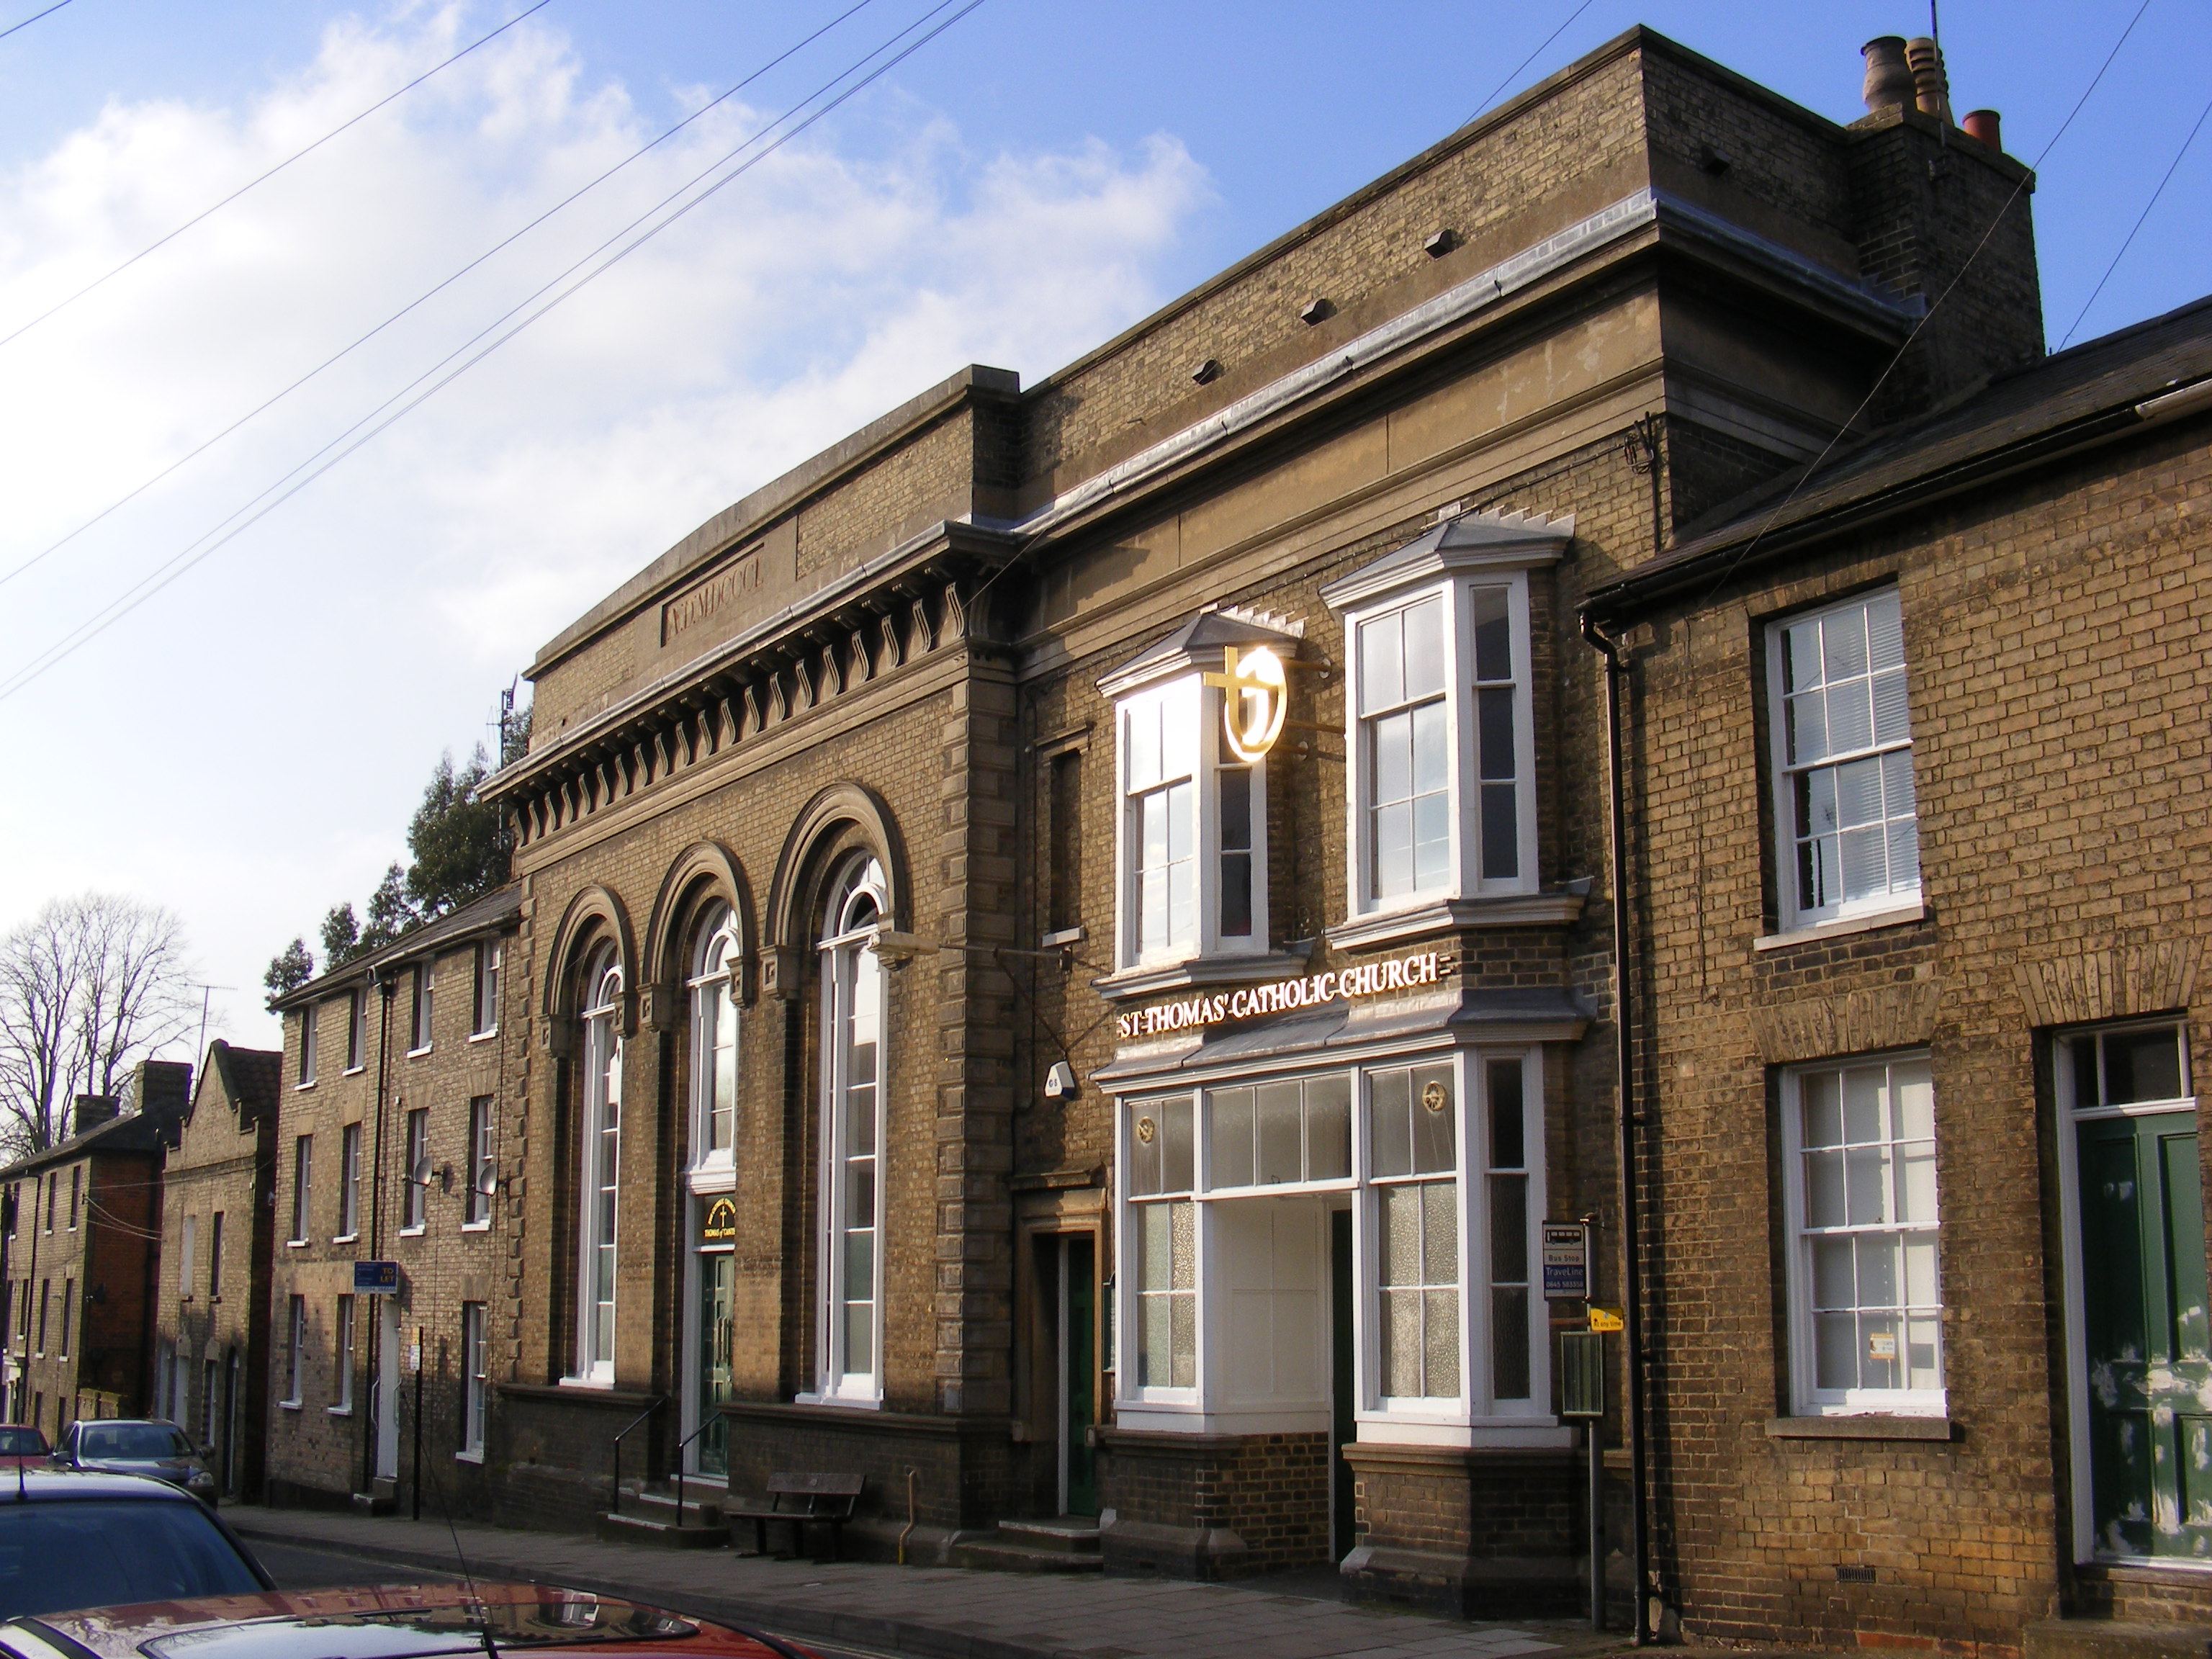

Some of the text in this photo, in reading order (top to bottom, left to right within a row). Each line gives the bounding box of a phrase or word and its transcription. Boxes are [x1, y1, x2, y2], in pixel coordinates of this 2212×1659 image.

[1119, 1010, 1143, 1038] ST
[1231, 973, 1337, 1019] CATHOLIC
[1339, 953, 1438, 997] CHURCH
